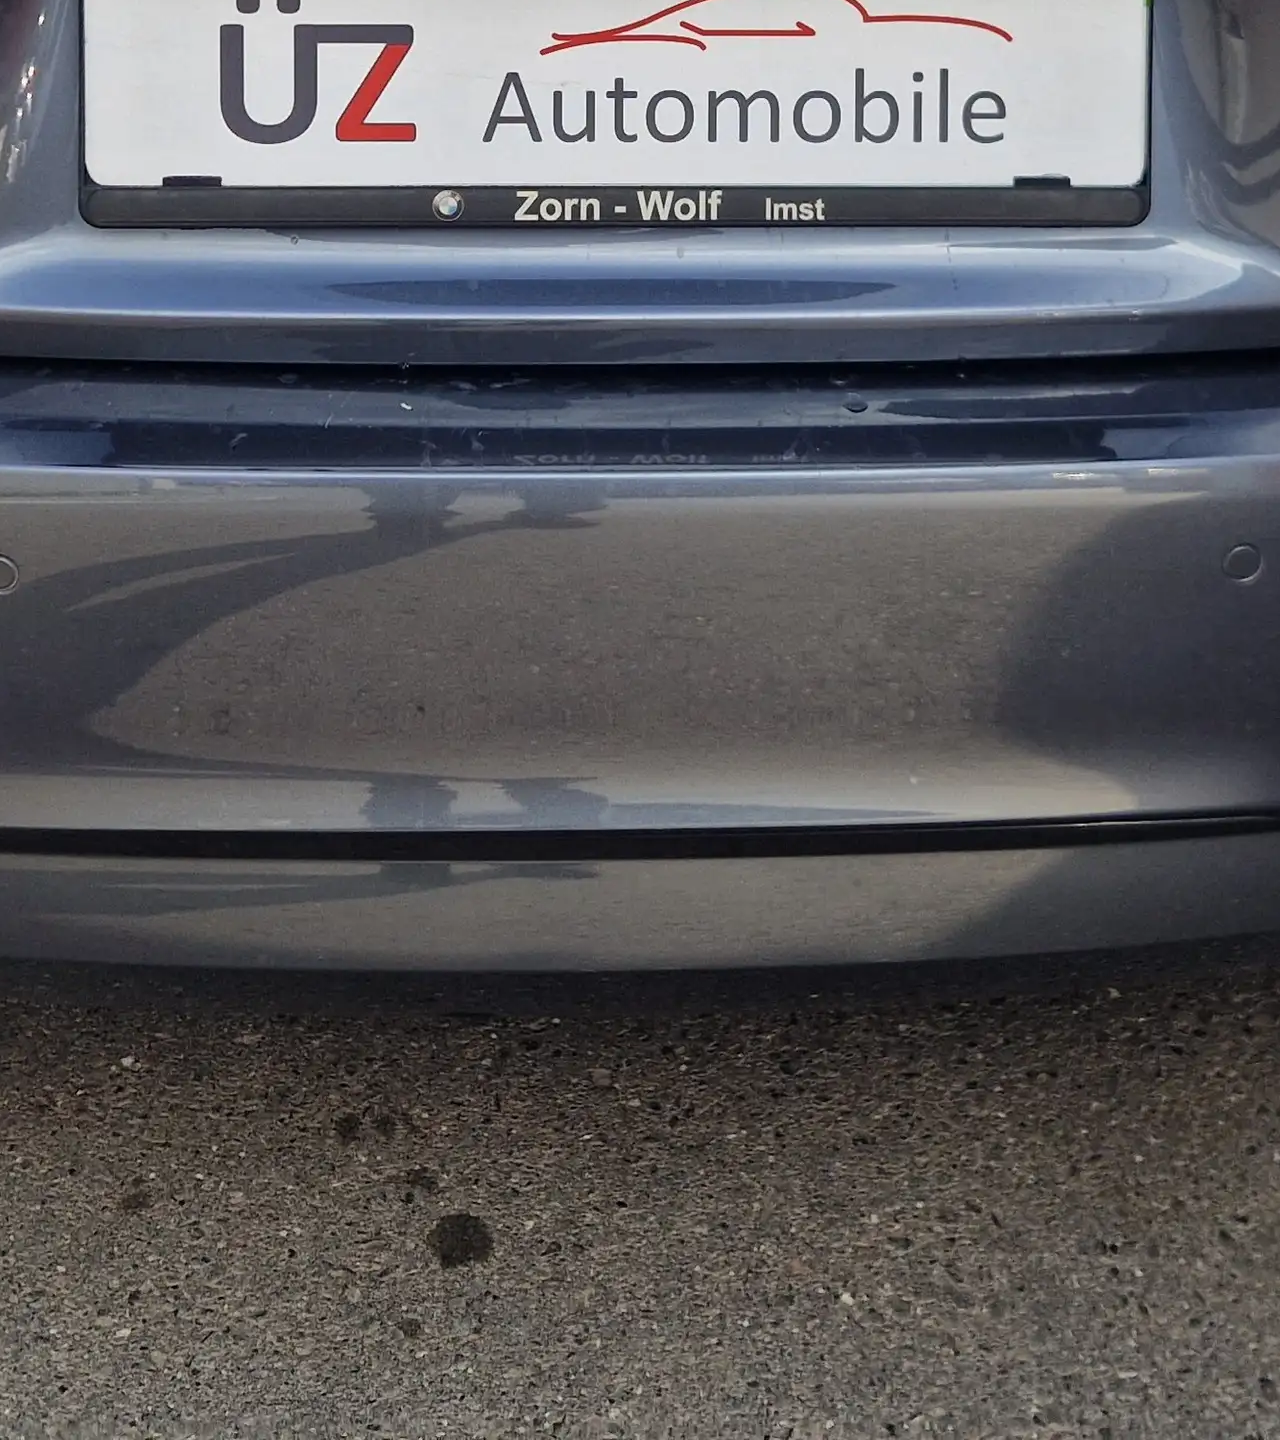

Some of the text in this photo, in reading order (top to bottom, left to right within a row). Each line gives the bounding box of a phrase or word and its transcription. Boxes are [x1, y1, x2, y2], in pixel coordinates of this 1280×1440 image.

[482, 68, 1008, 144] Automobile
[514, 190, 601, 221] Zorn
[636, 190, 722, 221] Wolf
[765, 197, 825, 221] Imst
